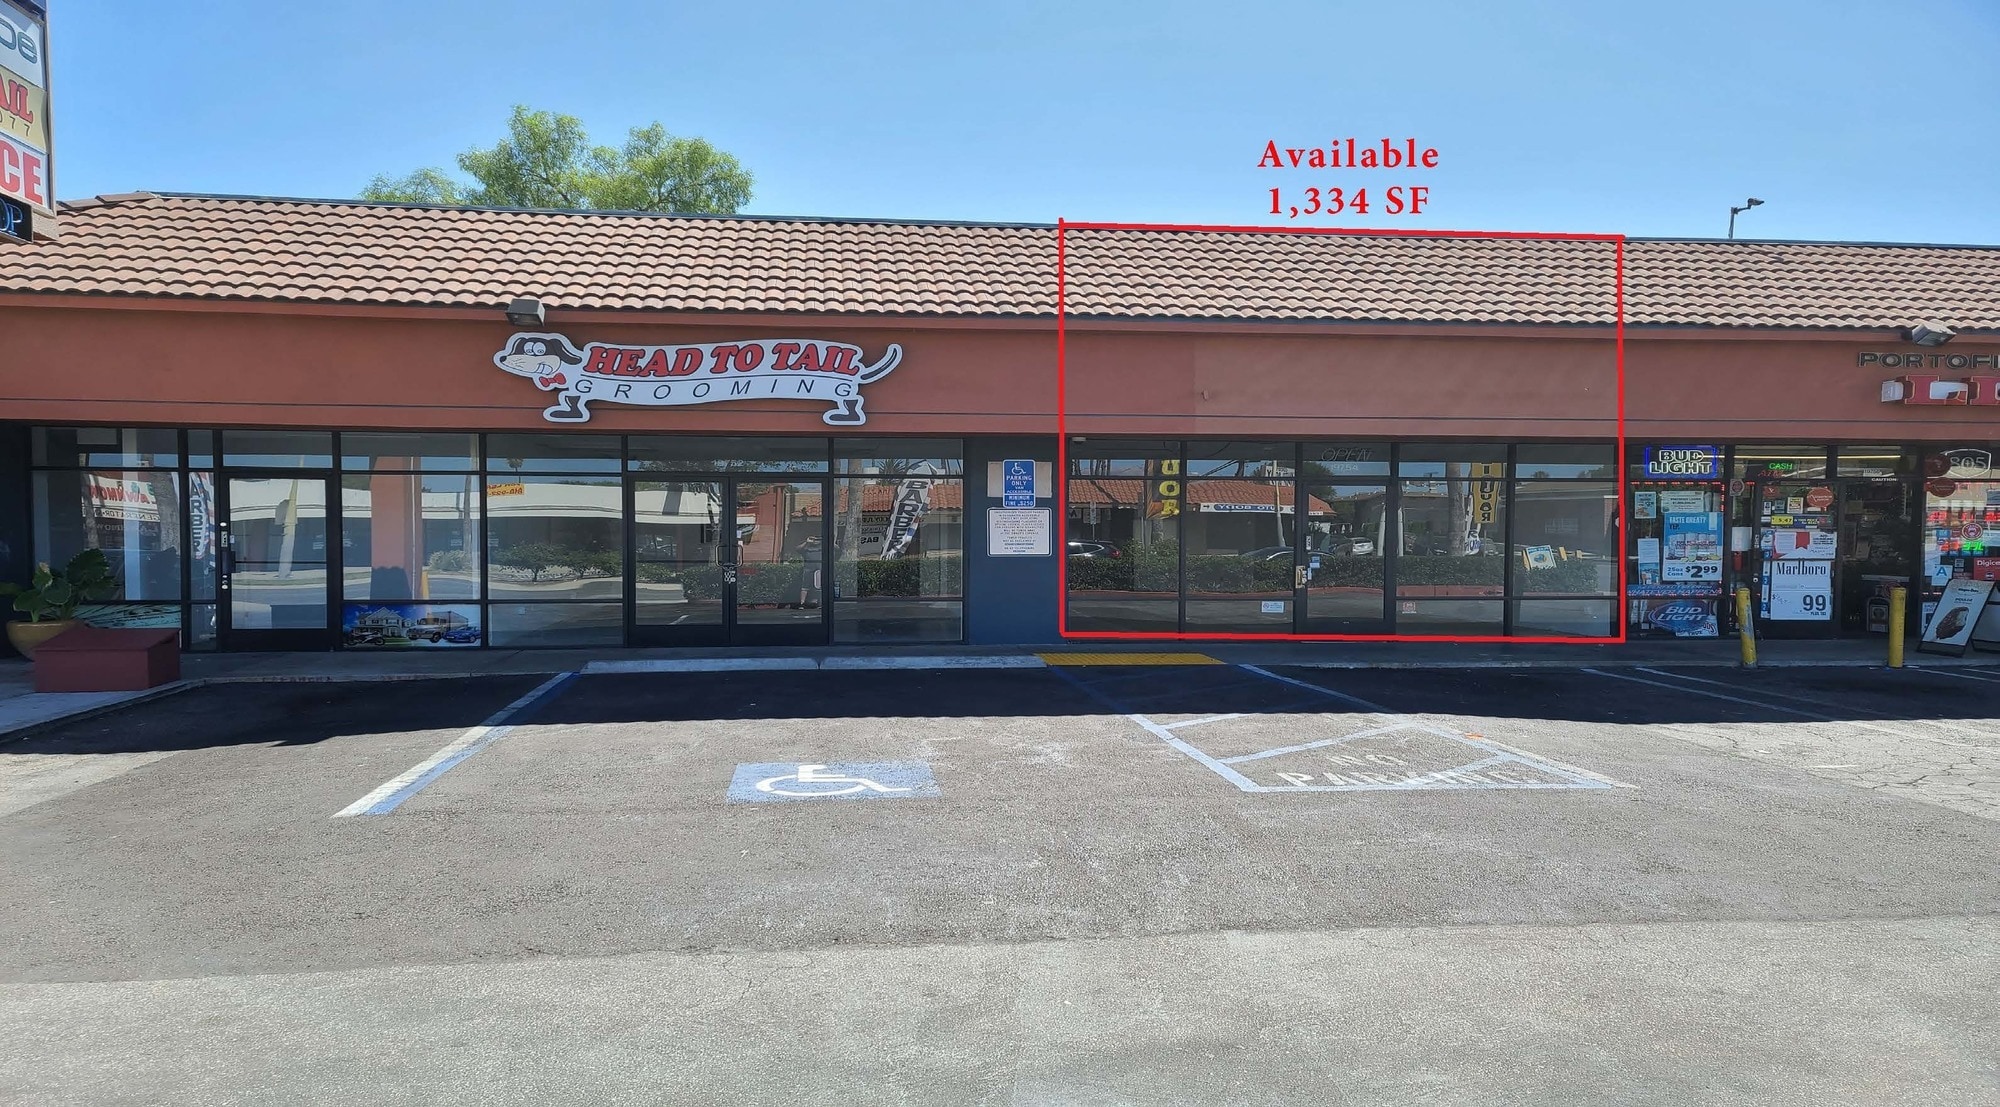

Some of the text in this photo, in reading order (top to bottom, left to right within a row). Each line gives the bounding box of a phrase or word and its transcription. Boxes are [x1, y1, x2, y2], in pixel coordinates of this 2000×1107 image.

[583, 342, 860, 377] HEAD TO TAIL
[574, 378, 853, 400] GROOMING
[1321, 448, 1372, 462] OPEN
[1658, 449, 1704, 462] BUD
[1649, 461, 1713, 475] LIGHT
[1769, 462, 1793, 470] CASH
[1949, 456, 1987, 469] 805
[1776, 560, 1826, 575] Marlboro
[1936, 566, 1948, 577] A
[1802, 594, 1827, 612] 99
[1665, 606, 1702, 614] BUD
[1656, 613, 1707, 621] LIGHT
